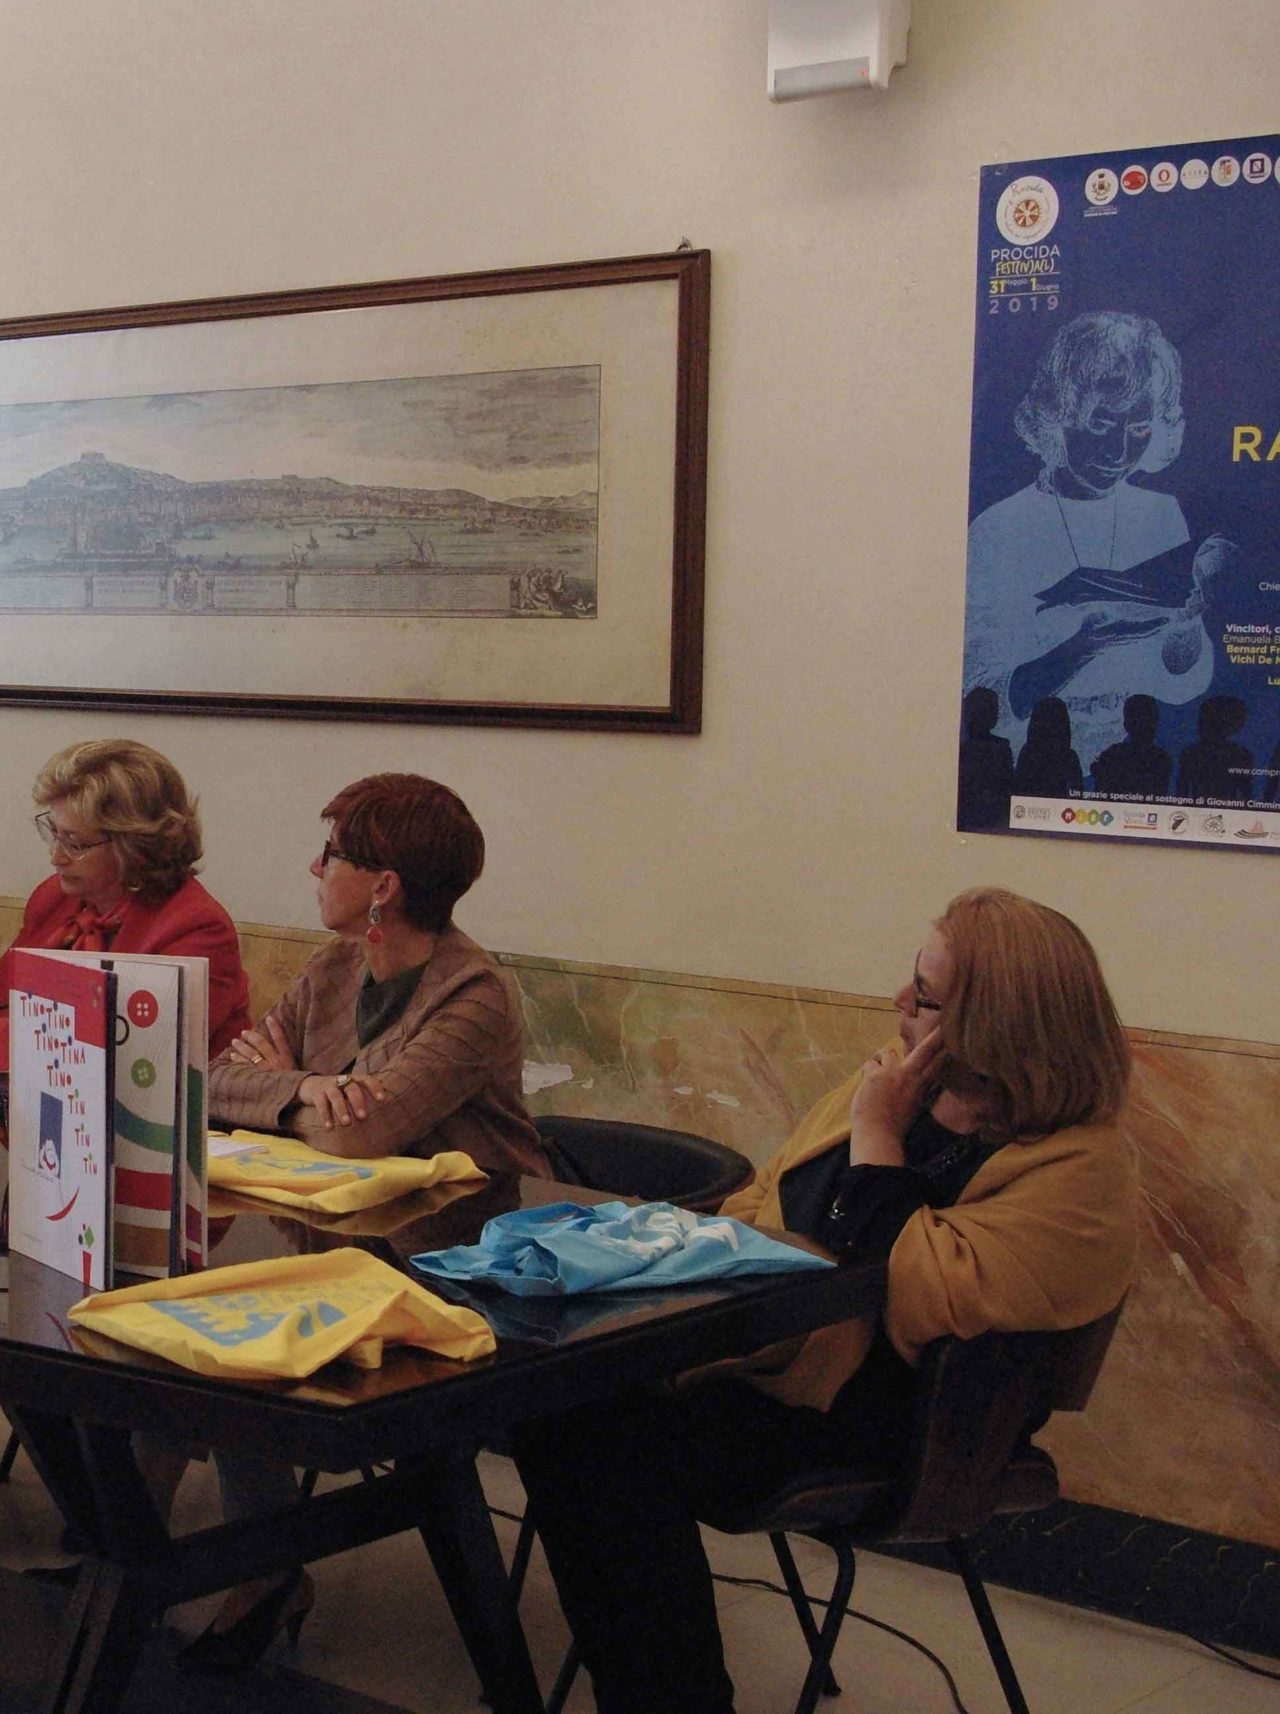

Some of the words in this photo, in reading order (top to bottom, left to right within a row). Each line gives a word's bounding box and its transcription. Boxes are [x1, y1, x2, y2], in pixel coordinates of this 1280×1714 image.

[991, 245, 1060, 261] PROCIDA
[989, 278, 1005, 294] 31
[1030, 277, 1036, 292] 1
[1226, 623, 1272, 635] Vincitori,
[1223, 634, 1271, 644] Emanuela
[1227, 645, 1267, 654] Bernard
[1230, 654, 1255, 664] Vichi
[1258, 655, 1272, 665] De
[1069, 789, 1081, 798] Un
[1083, 791, 1107, 800] grazie
[1110, 791, 1144, 801] speciale
[1145, 794, 1154, 802] al
[1155, 796, 1194, 805] sostegno
[1196, 797, 1205, 805] di
[1206, 797, 1245, 808] Giovanni
